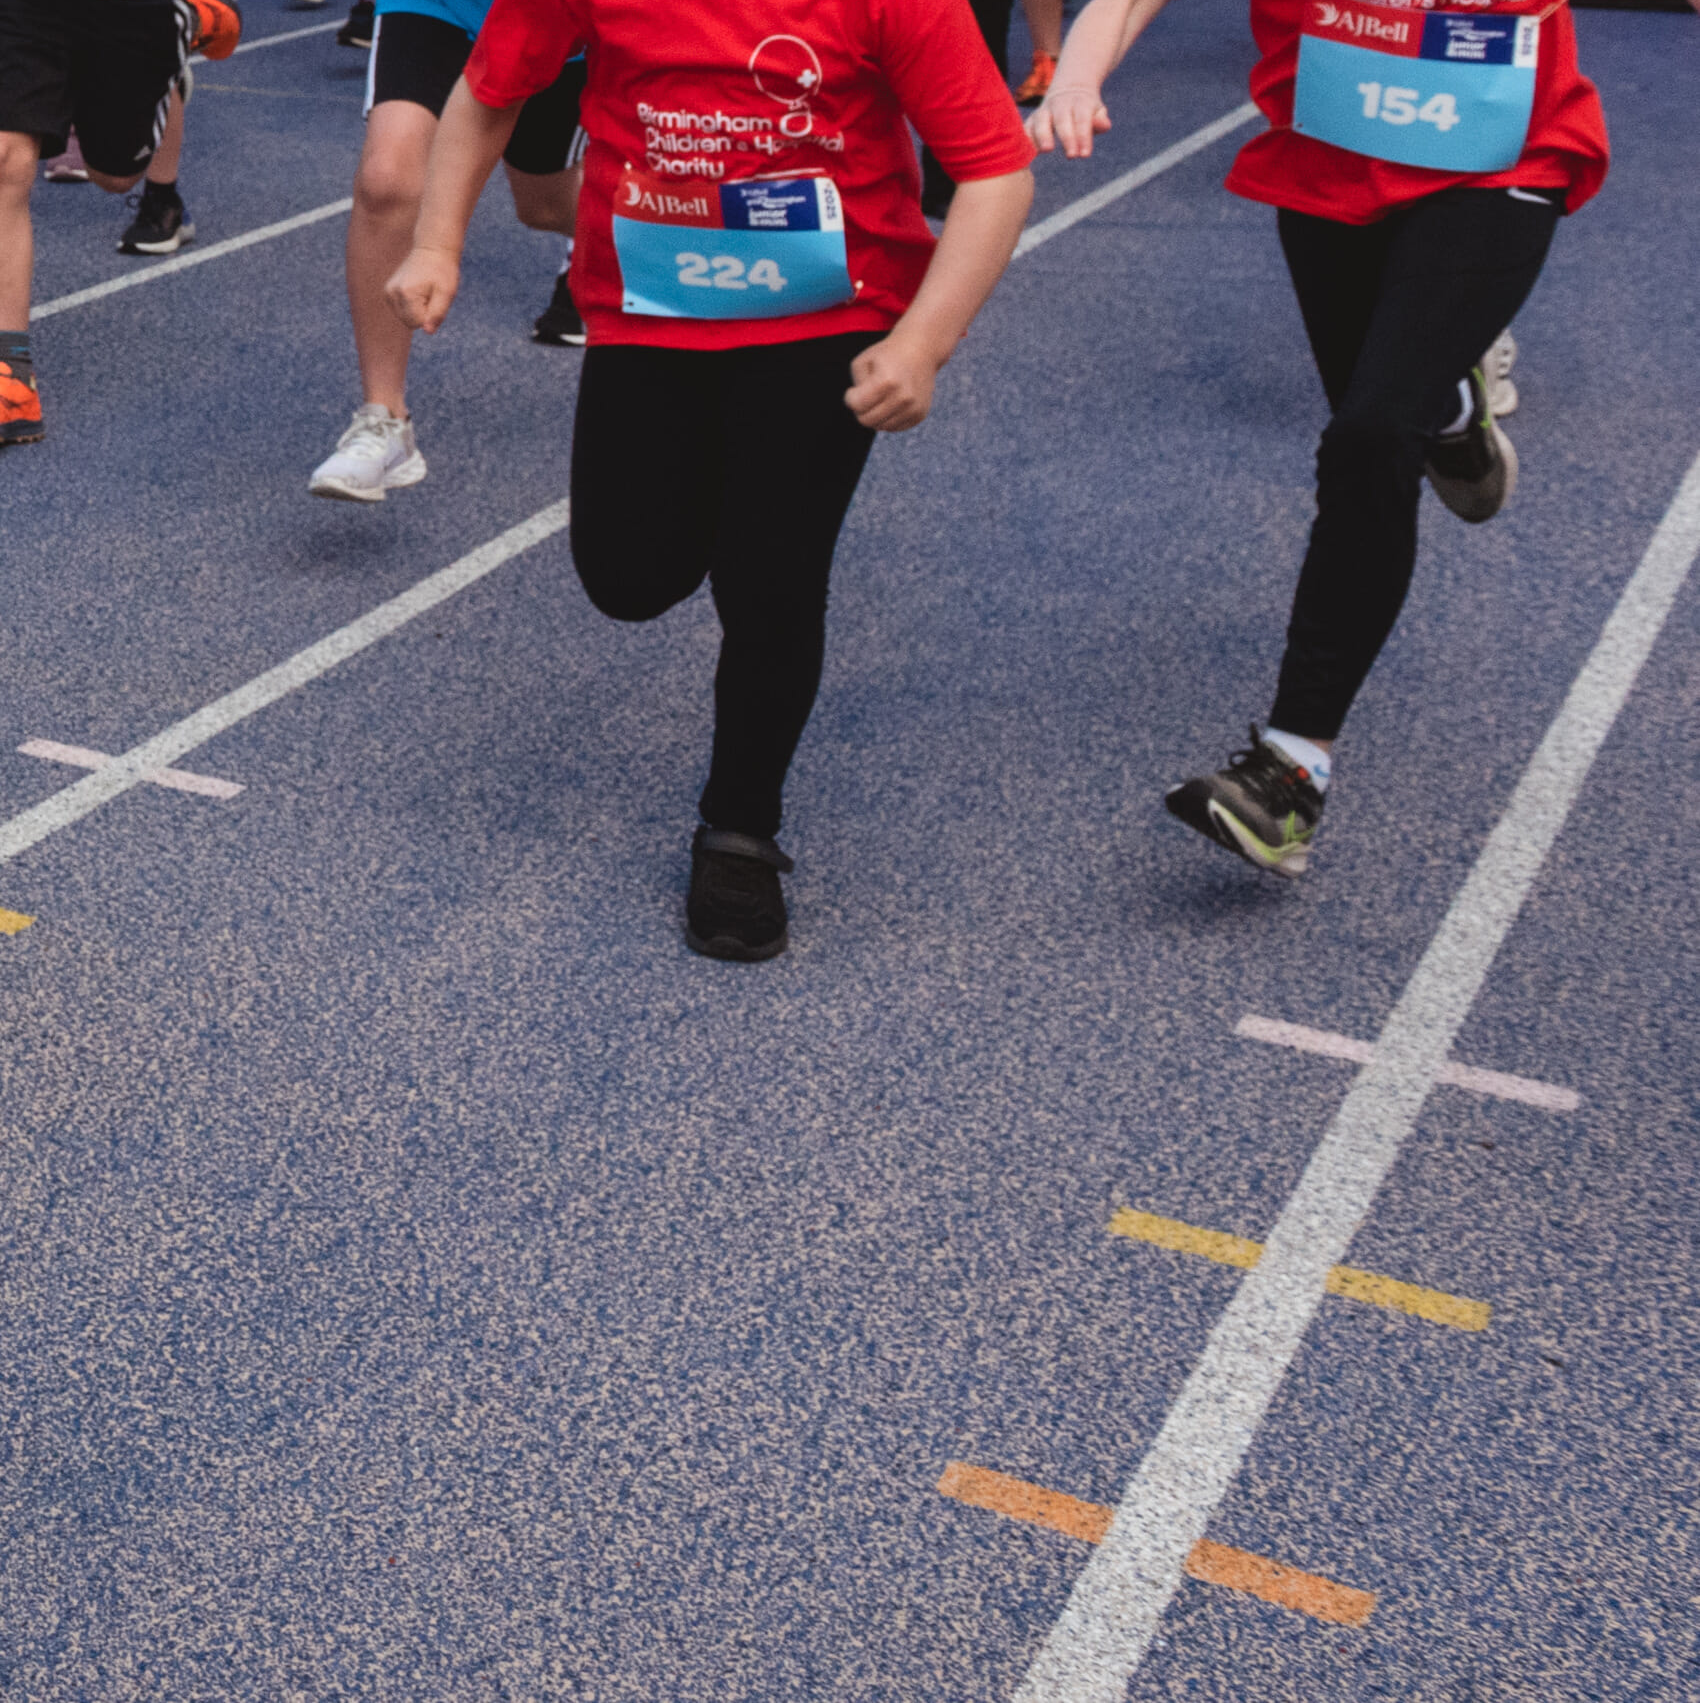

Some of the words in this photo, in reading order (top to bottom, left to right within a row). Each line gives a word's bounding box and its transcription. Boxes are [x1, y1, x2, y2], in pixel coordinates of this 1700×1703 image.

[1336, 10, 1410, 43] AJBell
[636, 102, 773, 134] Birmingham
[1357, 81, 1461, 132] 154
[645, 151, 725, 179] Charity
[640, 191, 709, 217] AJBell
[822, 187, 838, 221] 2025
[675, 252, 788, 292] 224
